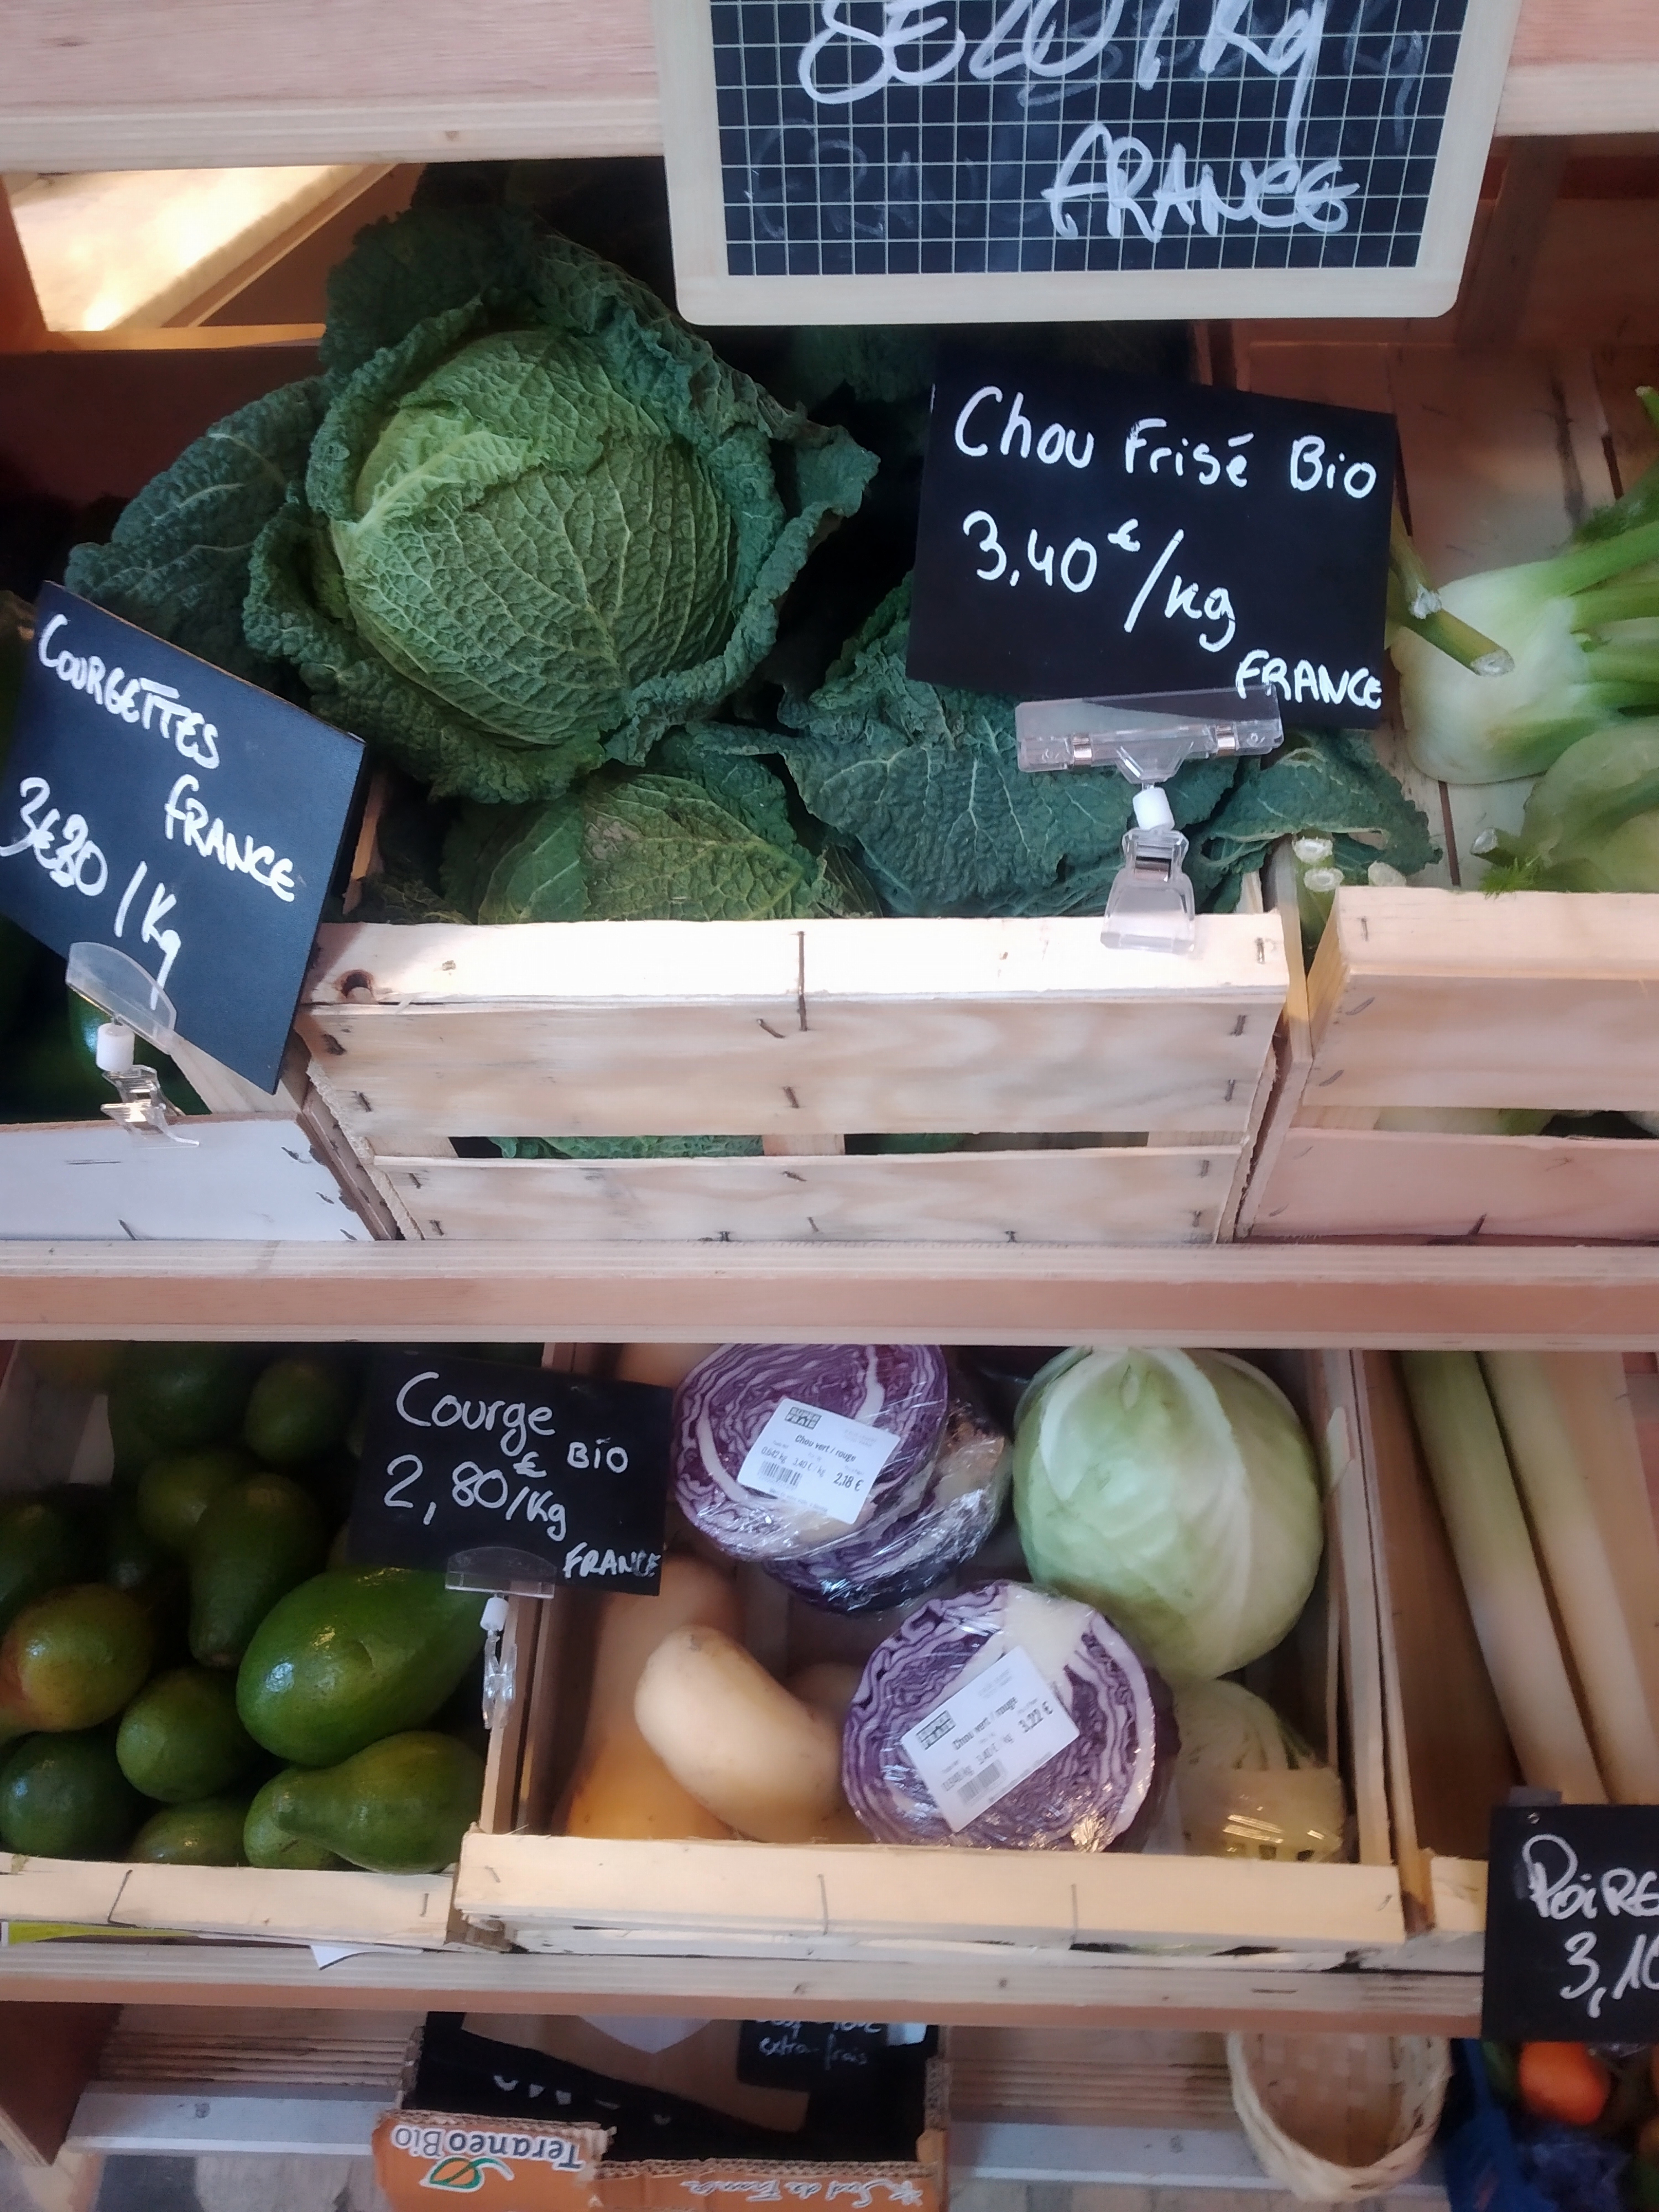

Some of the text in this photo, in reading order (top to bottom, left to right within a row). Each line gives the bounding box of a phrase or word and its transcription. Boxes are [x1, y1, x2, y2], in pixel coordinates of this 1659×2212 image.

[954, 385, 1377, 499] Chou Frisé Bio
[1235, 649, 1383, 710] FRANCE
[164, 774, 295, 902] FRANCE
[395, 1371, 556, 1457] Courge
[795, 1434, 814, 1447] Chou
[815, 1442, 831, 1453] vert
[836, 1448, 857, 1463] rouge
[833, 1472, 864, 1491] 2,18 €
[563, 1542, 662, 1579] FRANCE
